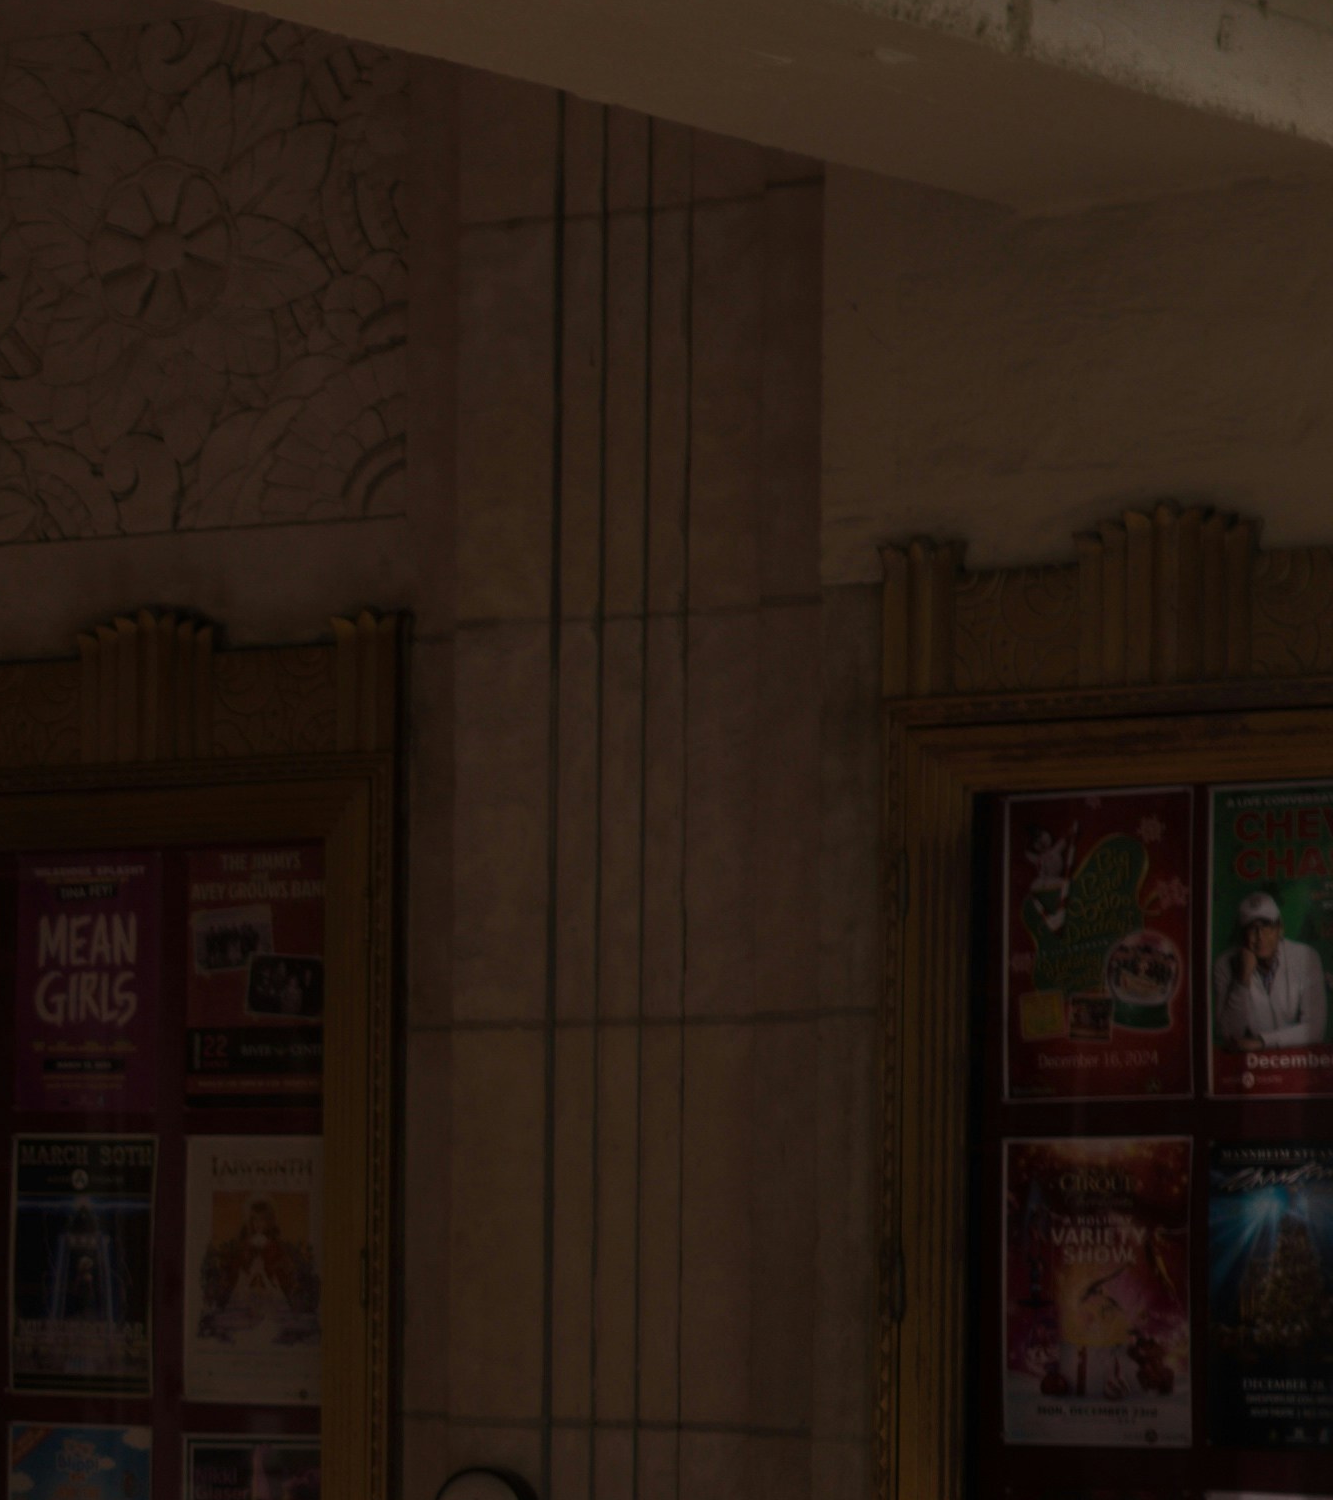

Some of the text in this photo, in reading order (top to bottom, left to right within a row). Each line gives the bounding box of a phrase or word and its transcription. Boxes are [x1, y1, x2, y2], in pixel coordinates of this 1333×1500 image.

[219, 853, 246, 870] THE
[1235, 845, 1333, 880] CHA
[37, 912, 137, 968] MEAN
[34, 970, 138, 1027] GIRLS
[1038, 1052, 1100, 1069] December
[1247, 1051, 1333, 1069] Decembe
[19, 1144, 88, 1166] MARCH
[1050, 1226, 1147, 1246] VARIETY
